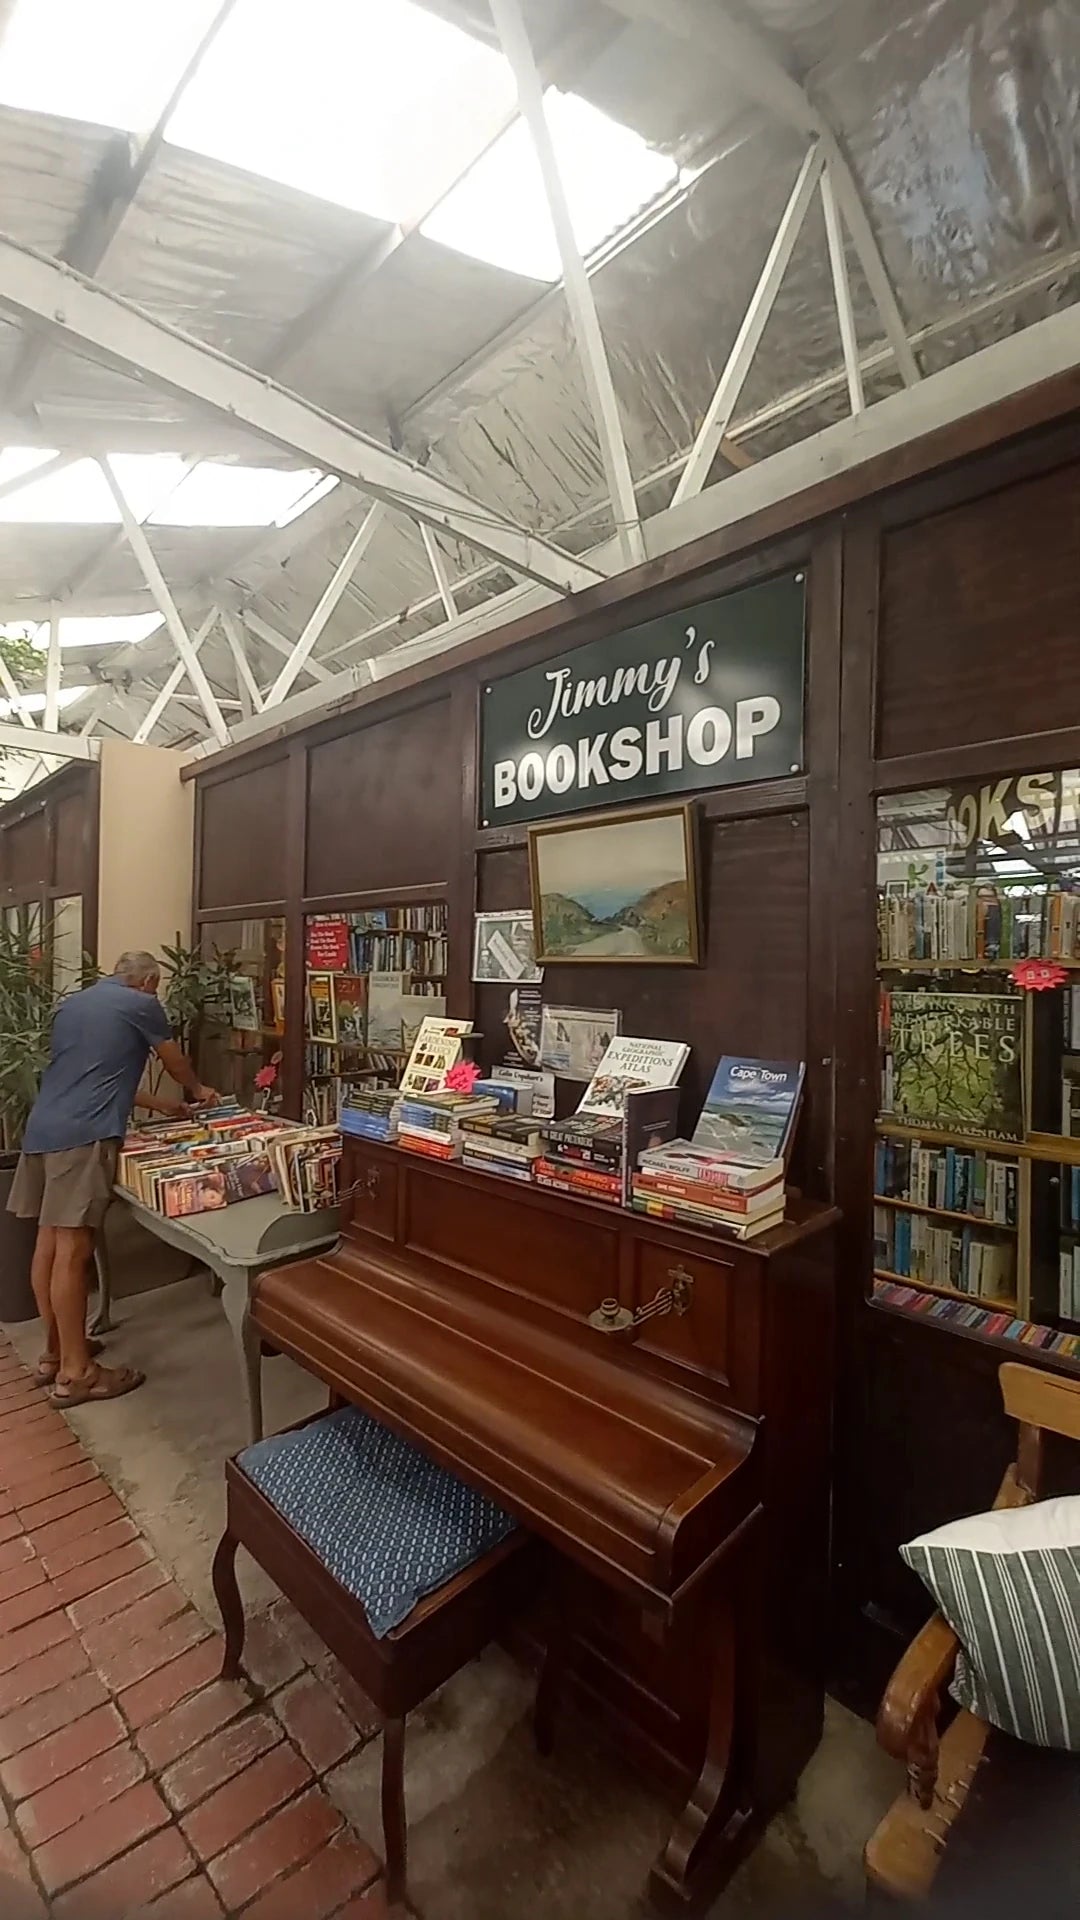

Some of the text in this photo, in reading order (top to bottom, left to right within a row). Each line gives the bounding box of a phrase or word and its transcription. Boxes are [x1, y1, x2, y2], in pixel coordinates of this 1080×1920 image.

[527, 626, 716, 740] Jimmy's
[494, 696, 782, 809] BOOKSHOP
[420, 1033, 458, 1048] GARDENING
[629, 1042, 662, 1051] NATIONAL
[892, 1027, 1016, 1063] TREES
[607, 1051, 674, 1067] EXPEDITIONS
[621, 1047, 665, 1057] GEOGRAPHIC
[620, 1062, 651, 1074] ATLAS
[730, 1066, 788, 1081] Cape Town
[898, 1116, 1018, 1142] THOMAS PAKENHAM
[642, 1159, 691, 1173] MICHAEL WOLFF
